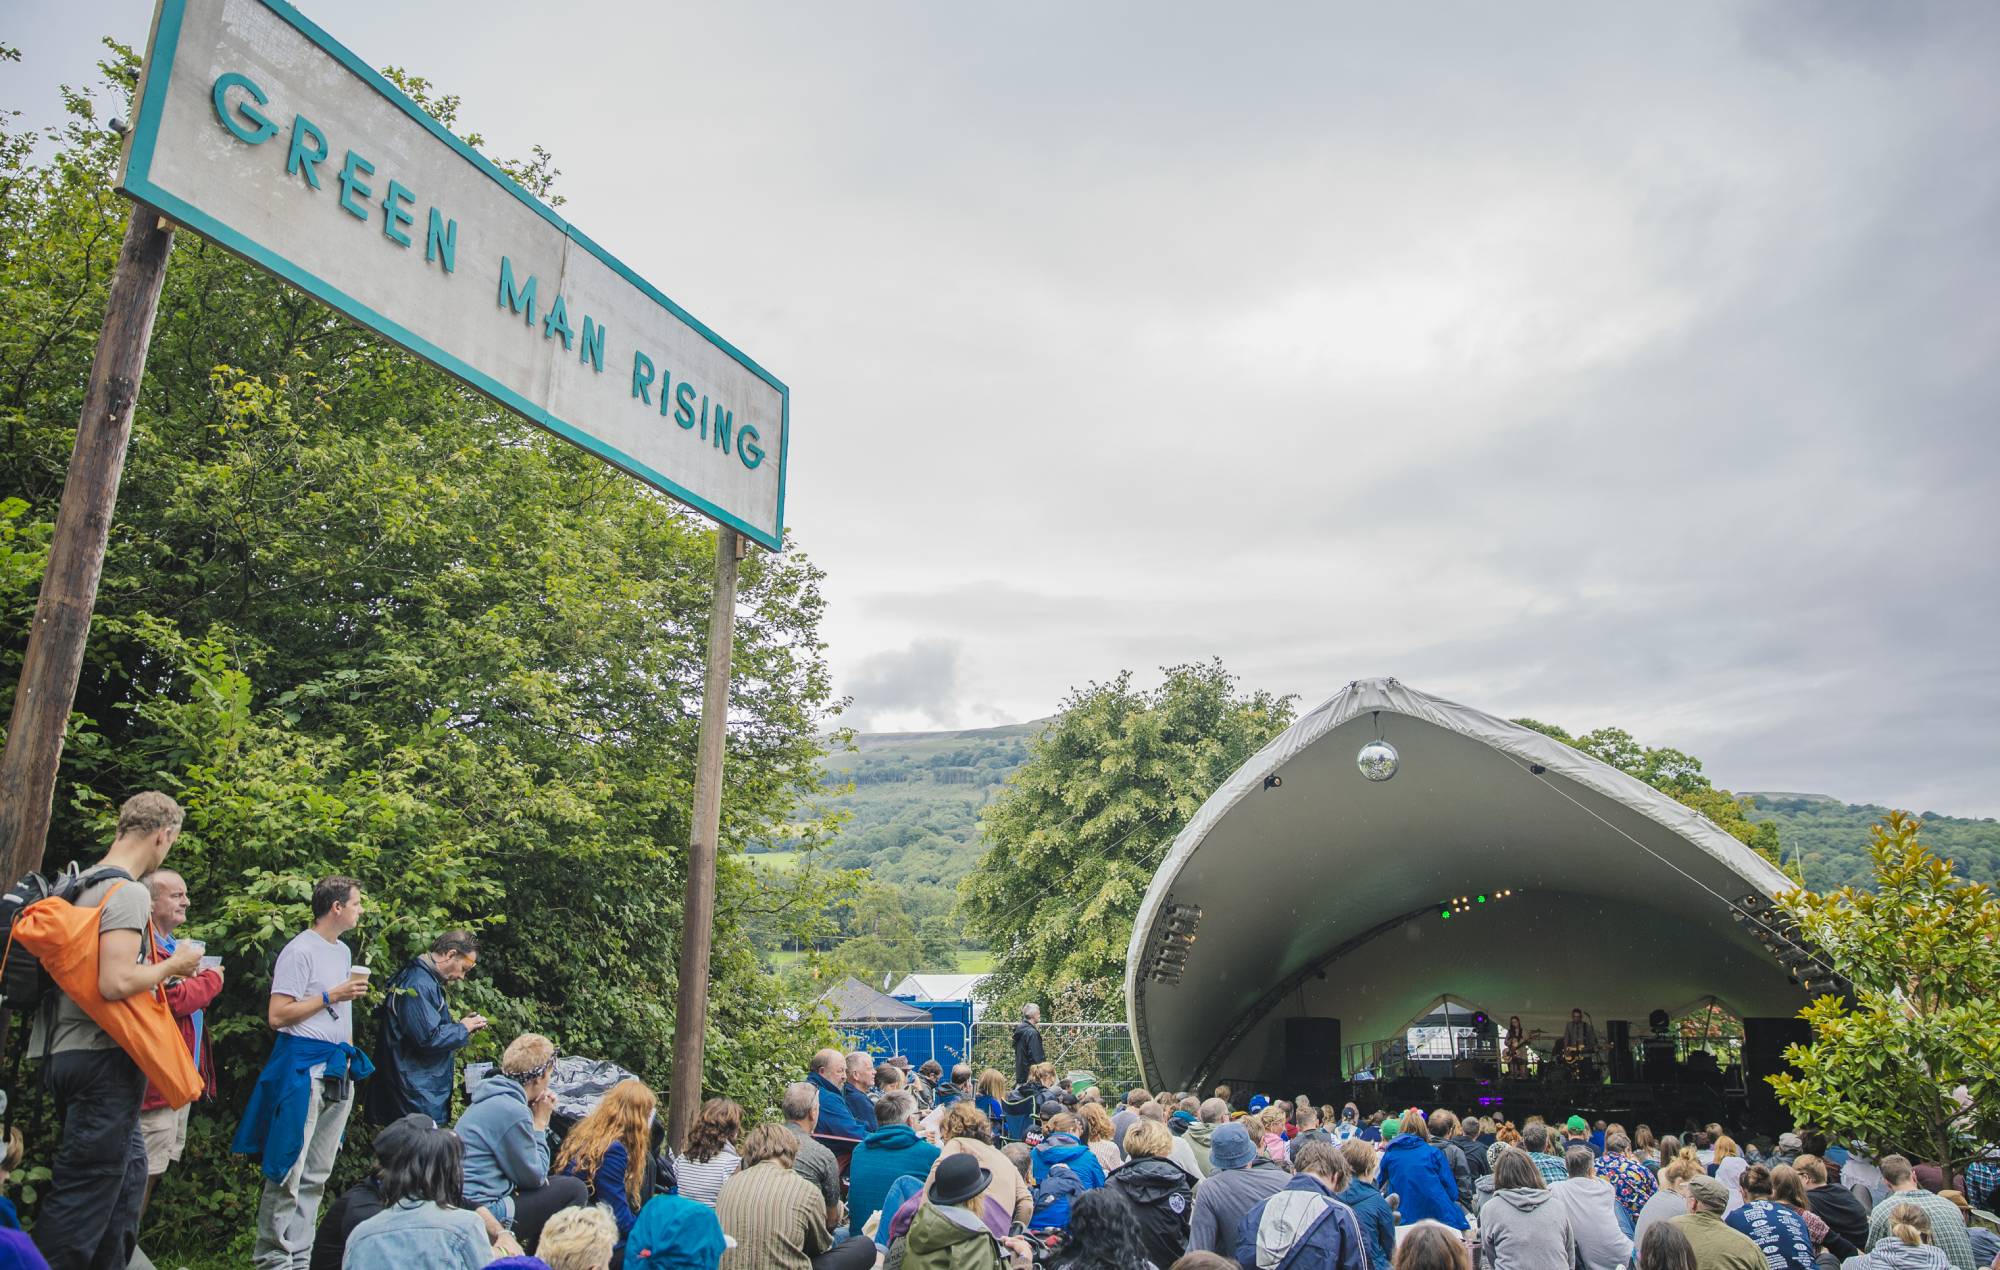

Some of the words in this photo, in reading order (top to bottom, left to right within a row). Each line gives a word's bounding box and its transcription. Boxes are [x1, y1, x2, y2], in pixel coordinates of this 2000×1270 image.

[213, 72, 457, 273] GREEN
[499, 256, 606, 373] MAN
[632, 350, 765, 470] RISING
